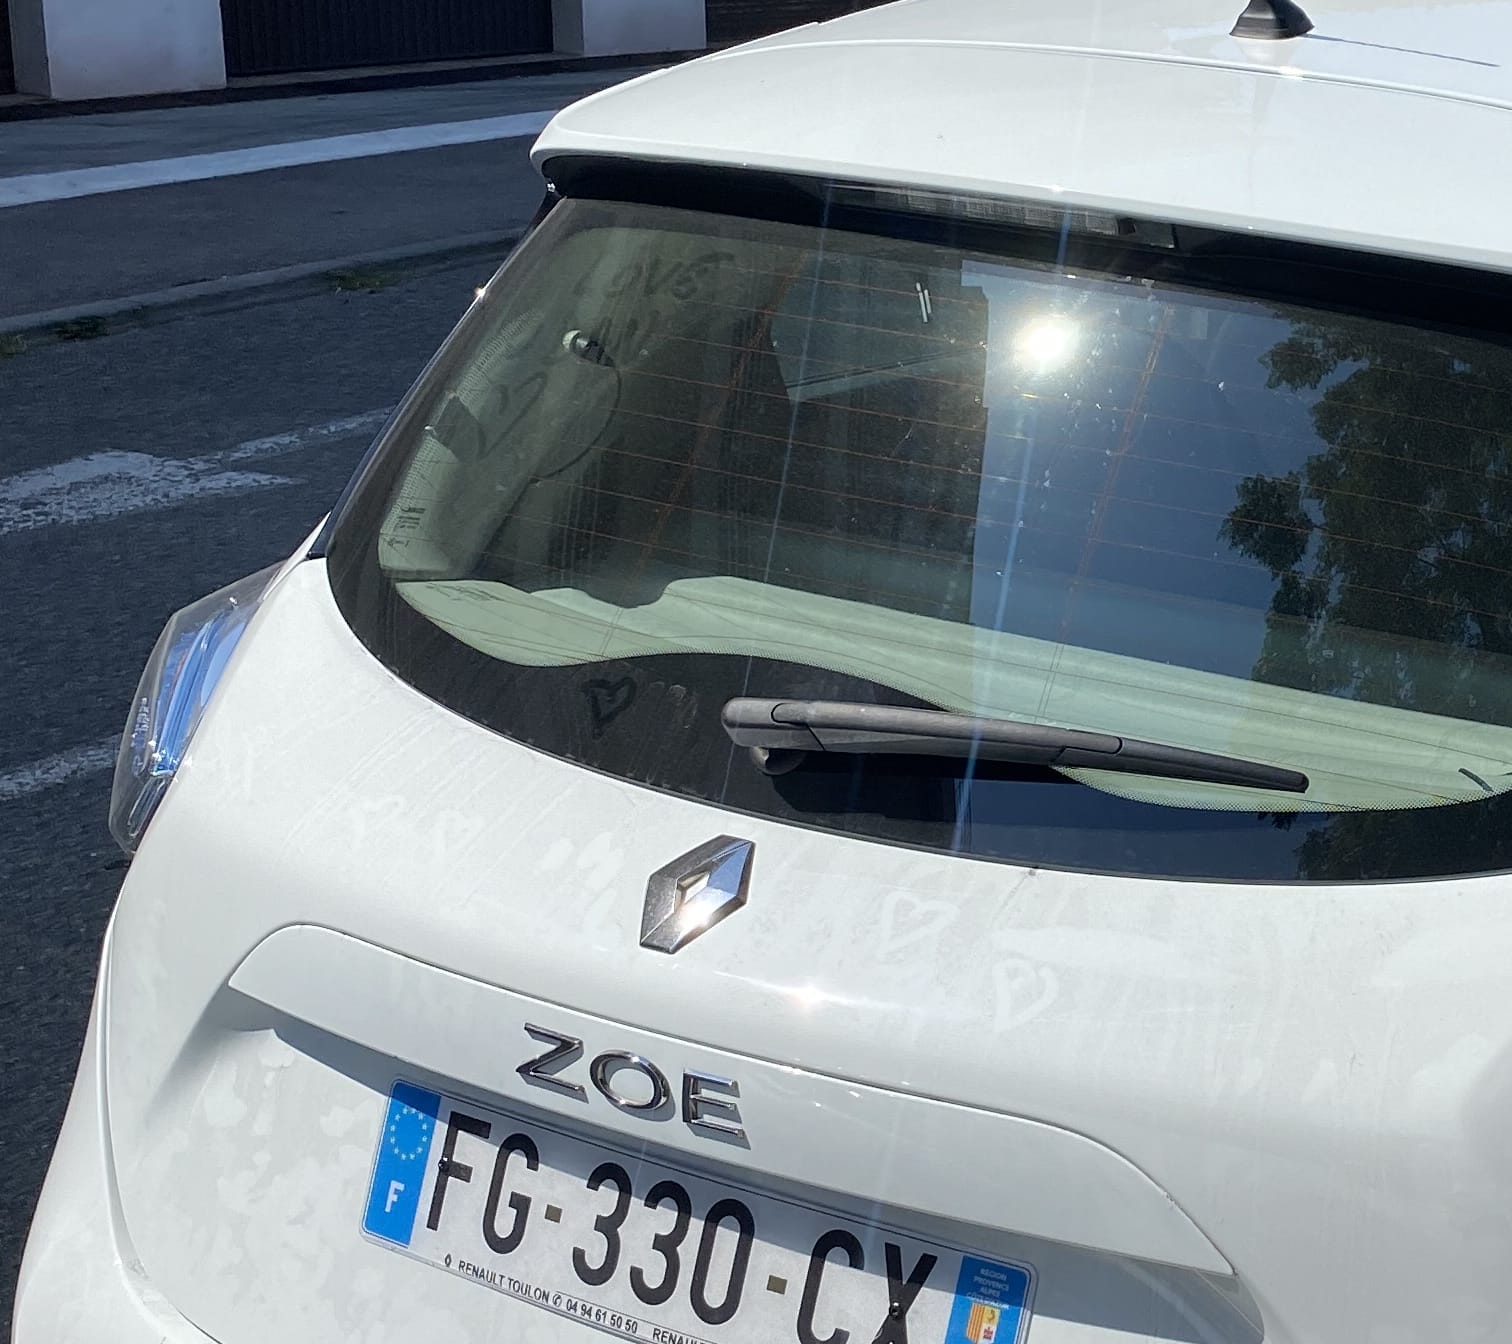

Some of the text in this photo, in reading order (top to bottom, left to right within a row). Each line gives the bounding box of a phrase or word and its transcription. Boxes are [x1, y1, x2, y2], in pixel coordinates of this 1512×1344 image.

[515, 1022, 746, 1140] ZOE
[385, 1180, 405, 1213] F
[458, 1260, 638, 1333] RENAULT TOULON 04 94 61 50 50
